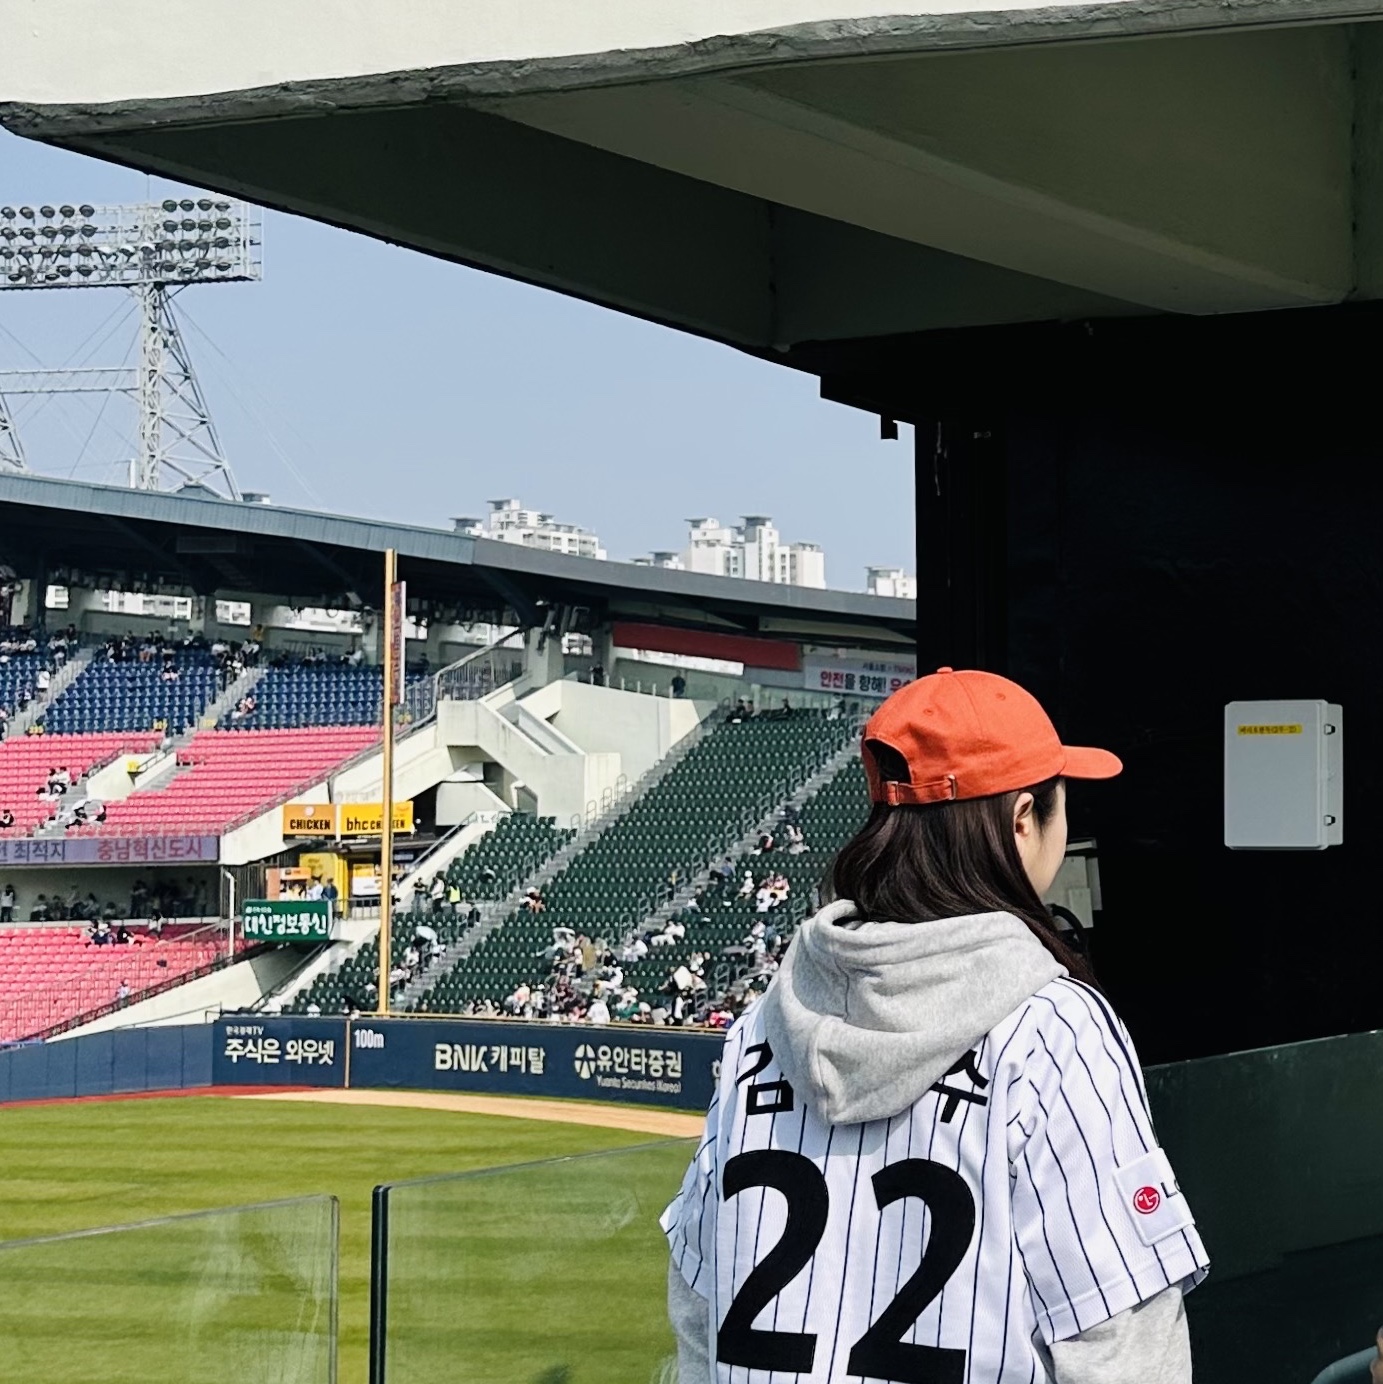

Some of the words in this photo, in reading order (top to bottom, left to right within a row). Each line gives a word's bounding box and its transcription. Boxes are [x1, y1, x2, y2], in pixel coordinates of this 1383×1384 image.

[820, 671, 855, 690] 안전을
[290, 818, 331, 830] CHICKEN
[346, 817, 369, 831] bhc
[14, 840, 66, 861] 최적지
[98, 836, 202, 861] 충남혁신도시
[244, 912, 327, 935] 대신정보통신
[354, 1029, 385, 1048] 100m
[224, 1038, 281, 1063] 주식은
[285, 1038, 334, 1065] 와우넷
[435, 1043, 489, 1072] BNK
[490, 1045, 546, 1074] 캐피탈
[597, 1045, 682, 1077] 유안타증권
